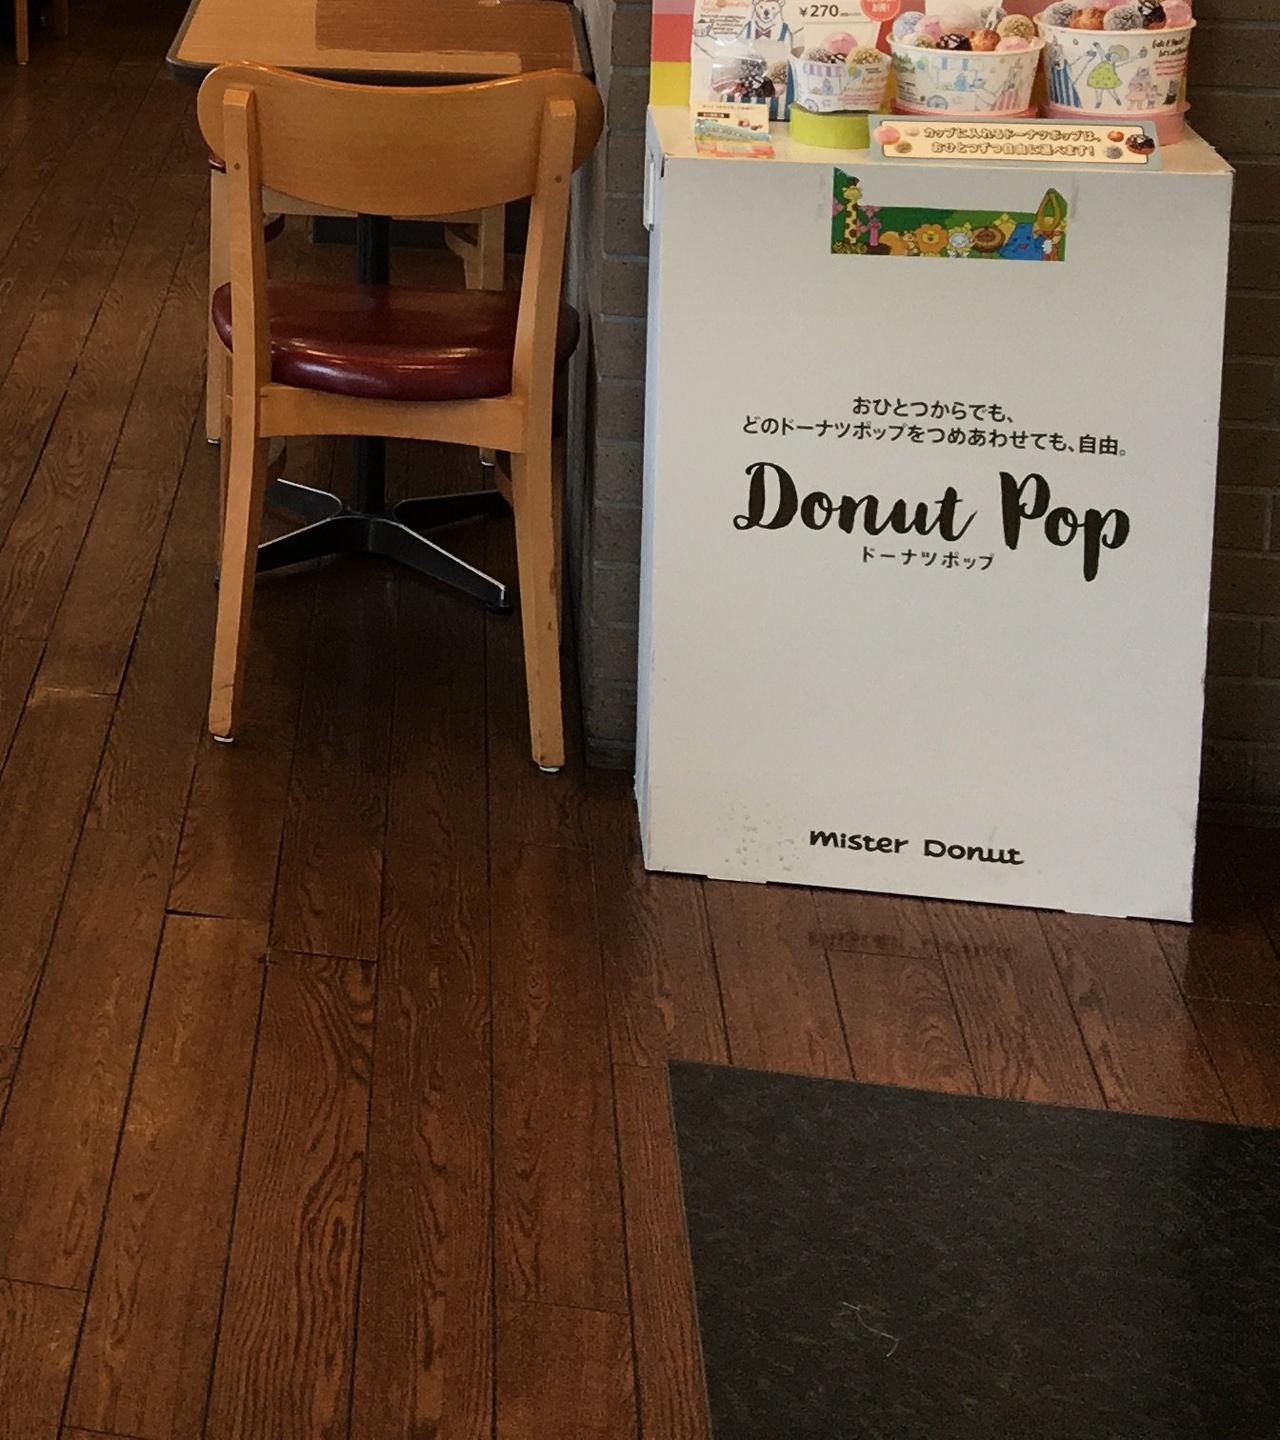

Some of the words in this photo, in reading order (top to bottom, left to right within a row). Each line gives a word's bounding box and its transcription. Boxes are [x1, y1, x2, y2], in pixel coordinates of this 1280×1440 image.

[799, 4, 839, 17] ¥270
[852, 396, 1014, 422] おひとつからでも、
[743, 415, 1127, 457] どのドーナツポップをつめあわせても、自由。
[733, 461, 978, 542] Donut
[999, 471, 1131, 582] Pop
[861, 546, 994, 571] ドーナツポップ
[809, 829, 909, 854] mister
[923, 838, 1025, 865] Donut
